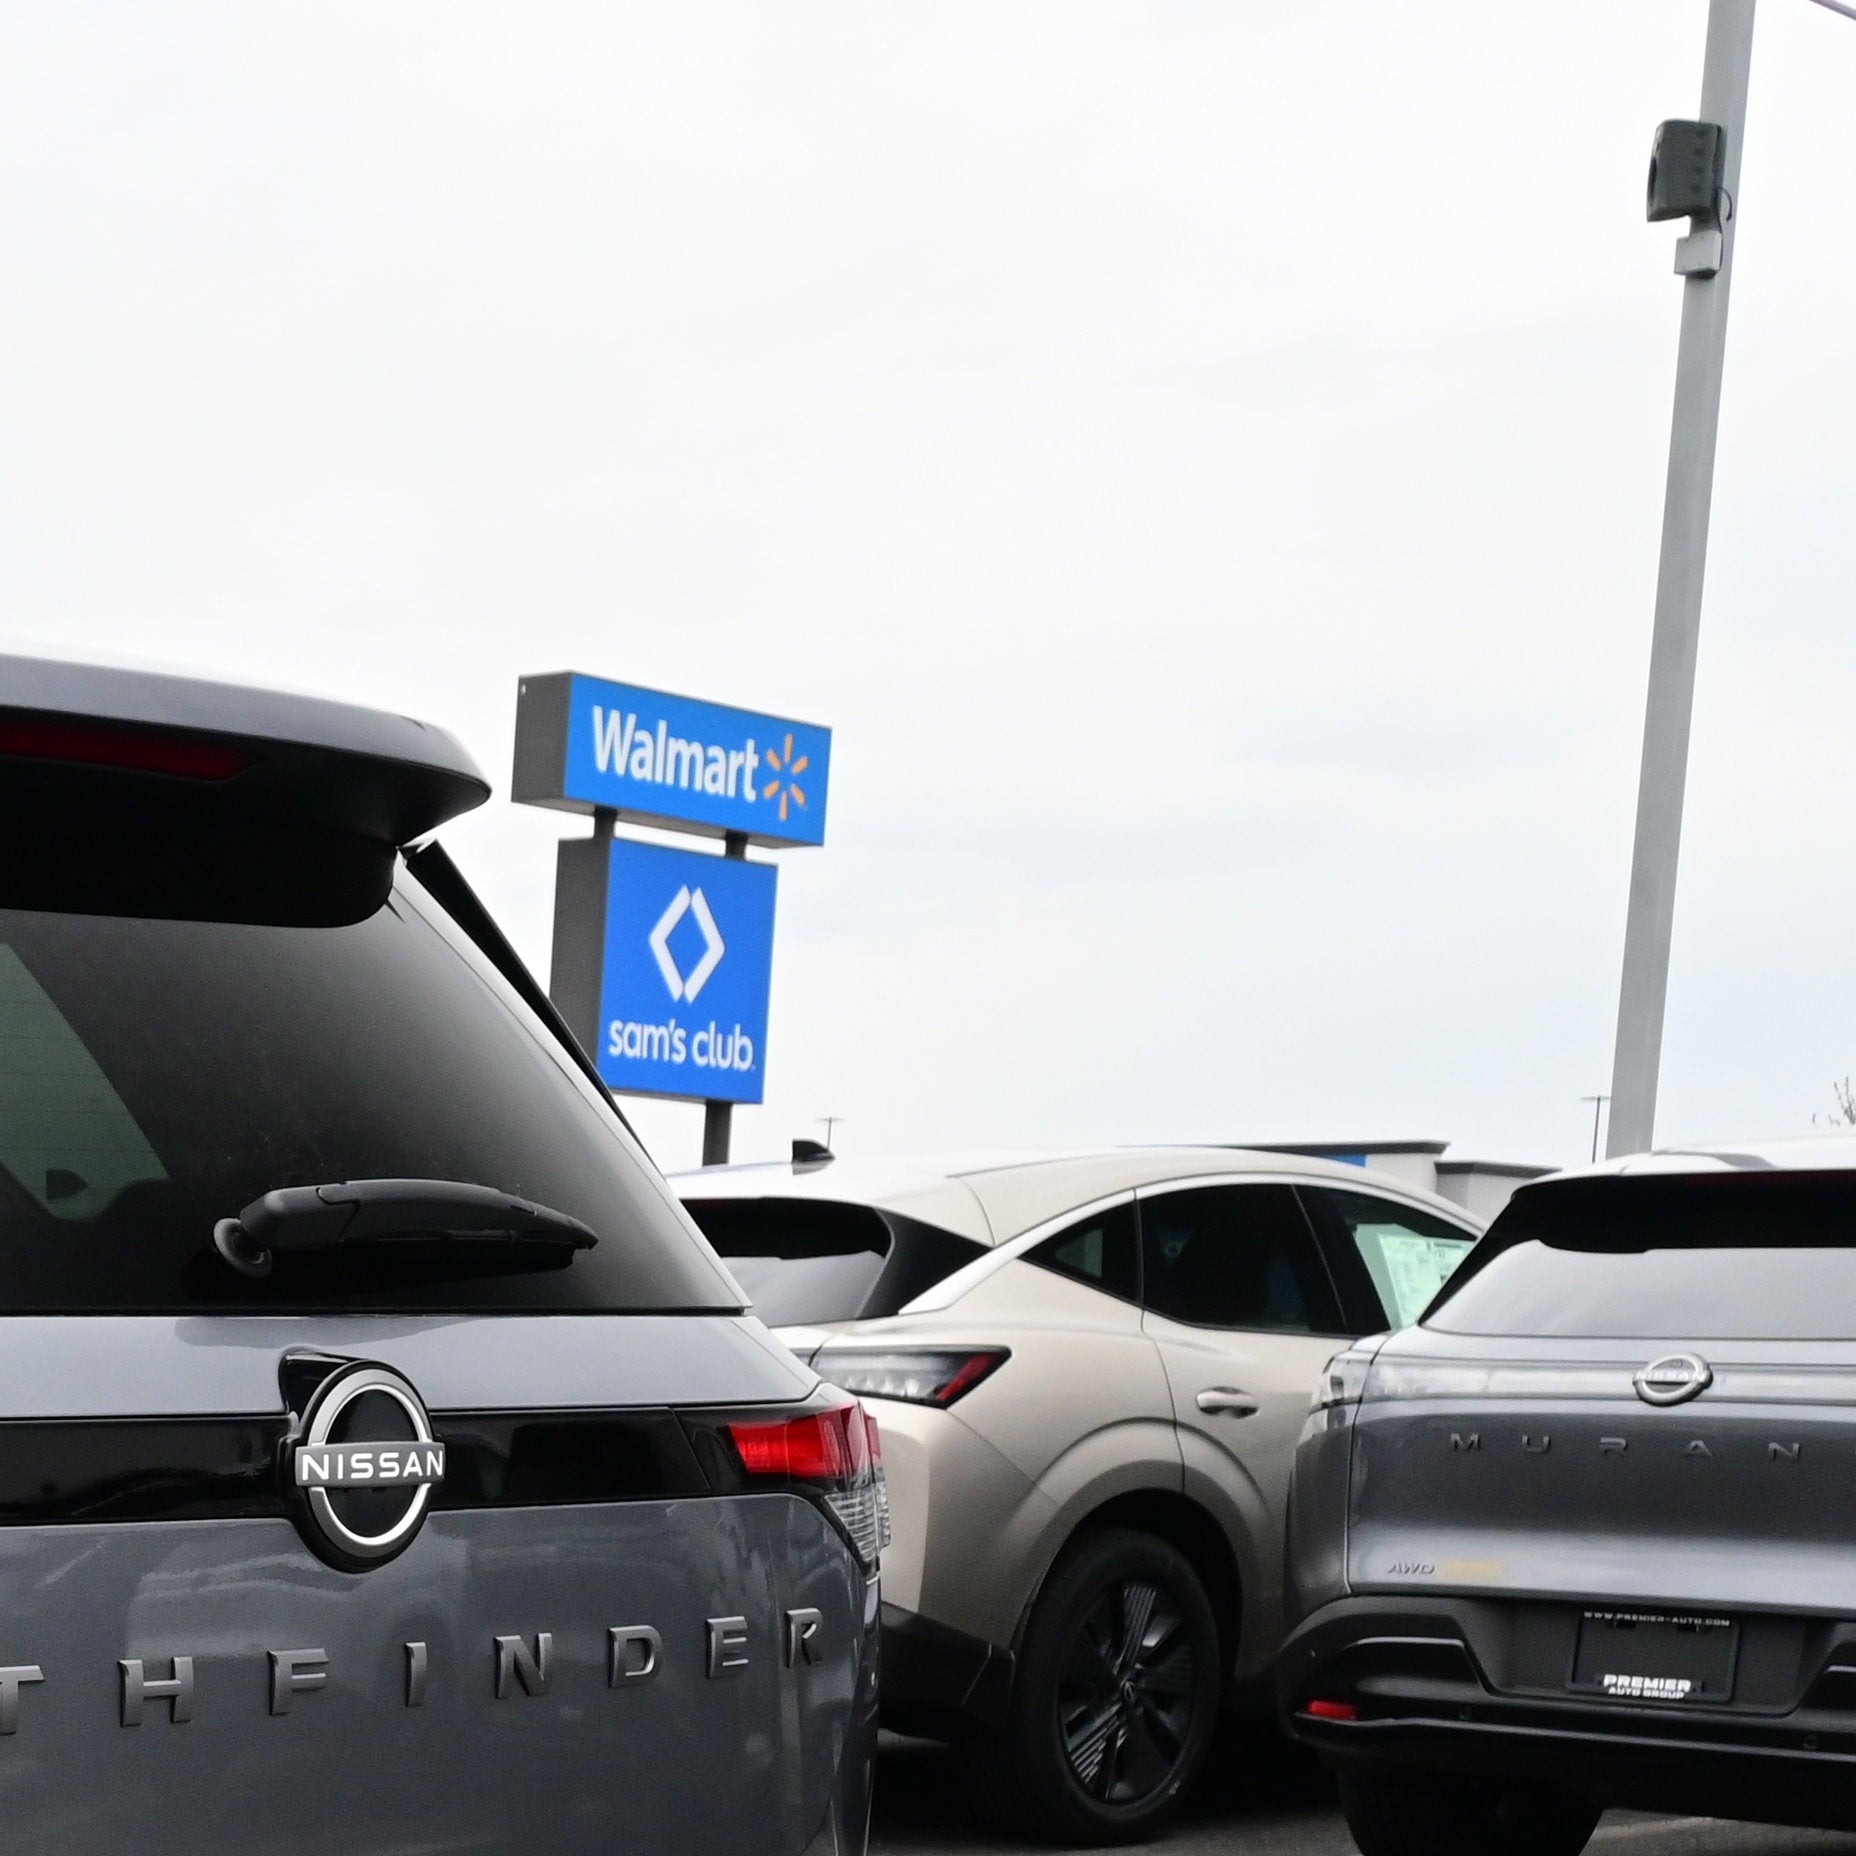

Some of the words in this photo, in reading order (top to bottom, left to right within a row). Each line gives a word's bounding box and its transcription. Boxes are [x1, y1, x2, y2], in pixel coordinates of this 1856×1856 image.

[592, 705, 759, 803] Walmart
[608, 1018, 687, 1065] sam's
[692, 1021, 754, 1070] club
[1636, 1370, 1707, 1382] NISSAN
[1450, 1432, 1856, 1460] MURAN
[301, 1450, 444, 1480] NISSAN
[1603, 1674, 1692, 1693] PREMIER
[1608, 1686, 1640, 1697] AUTO
[1643, 1687, 1685, 1700] GROUP
